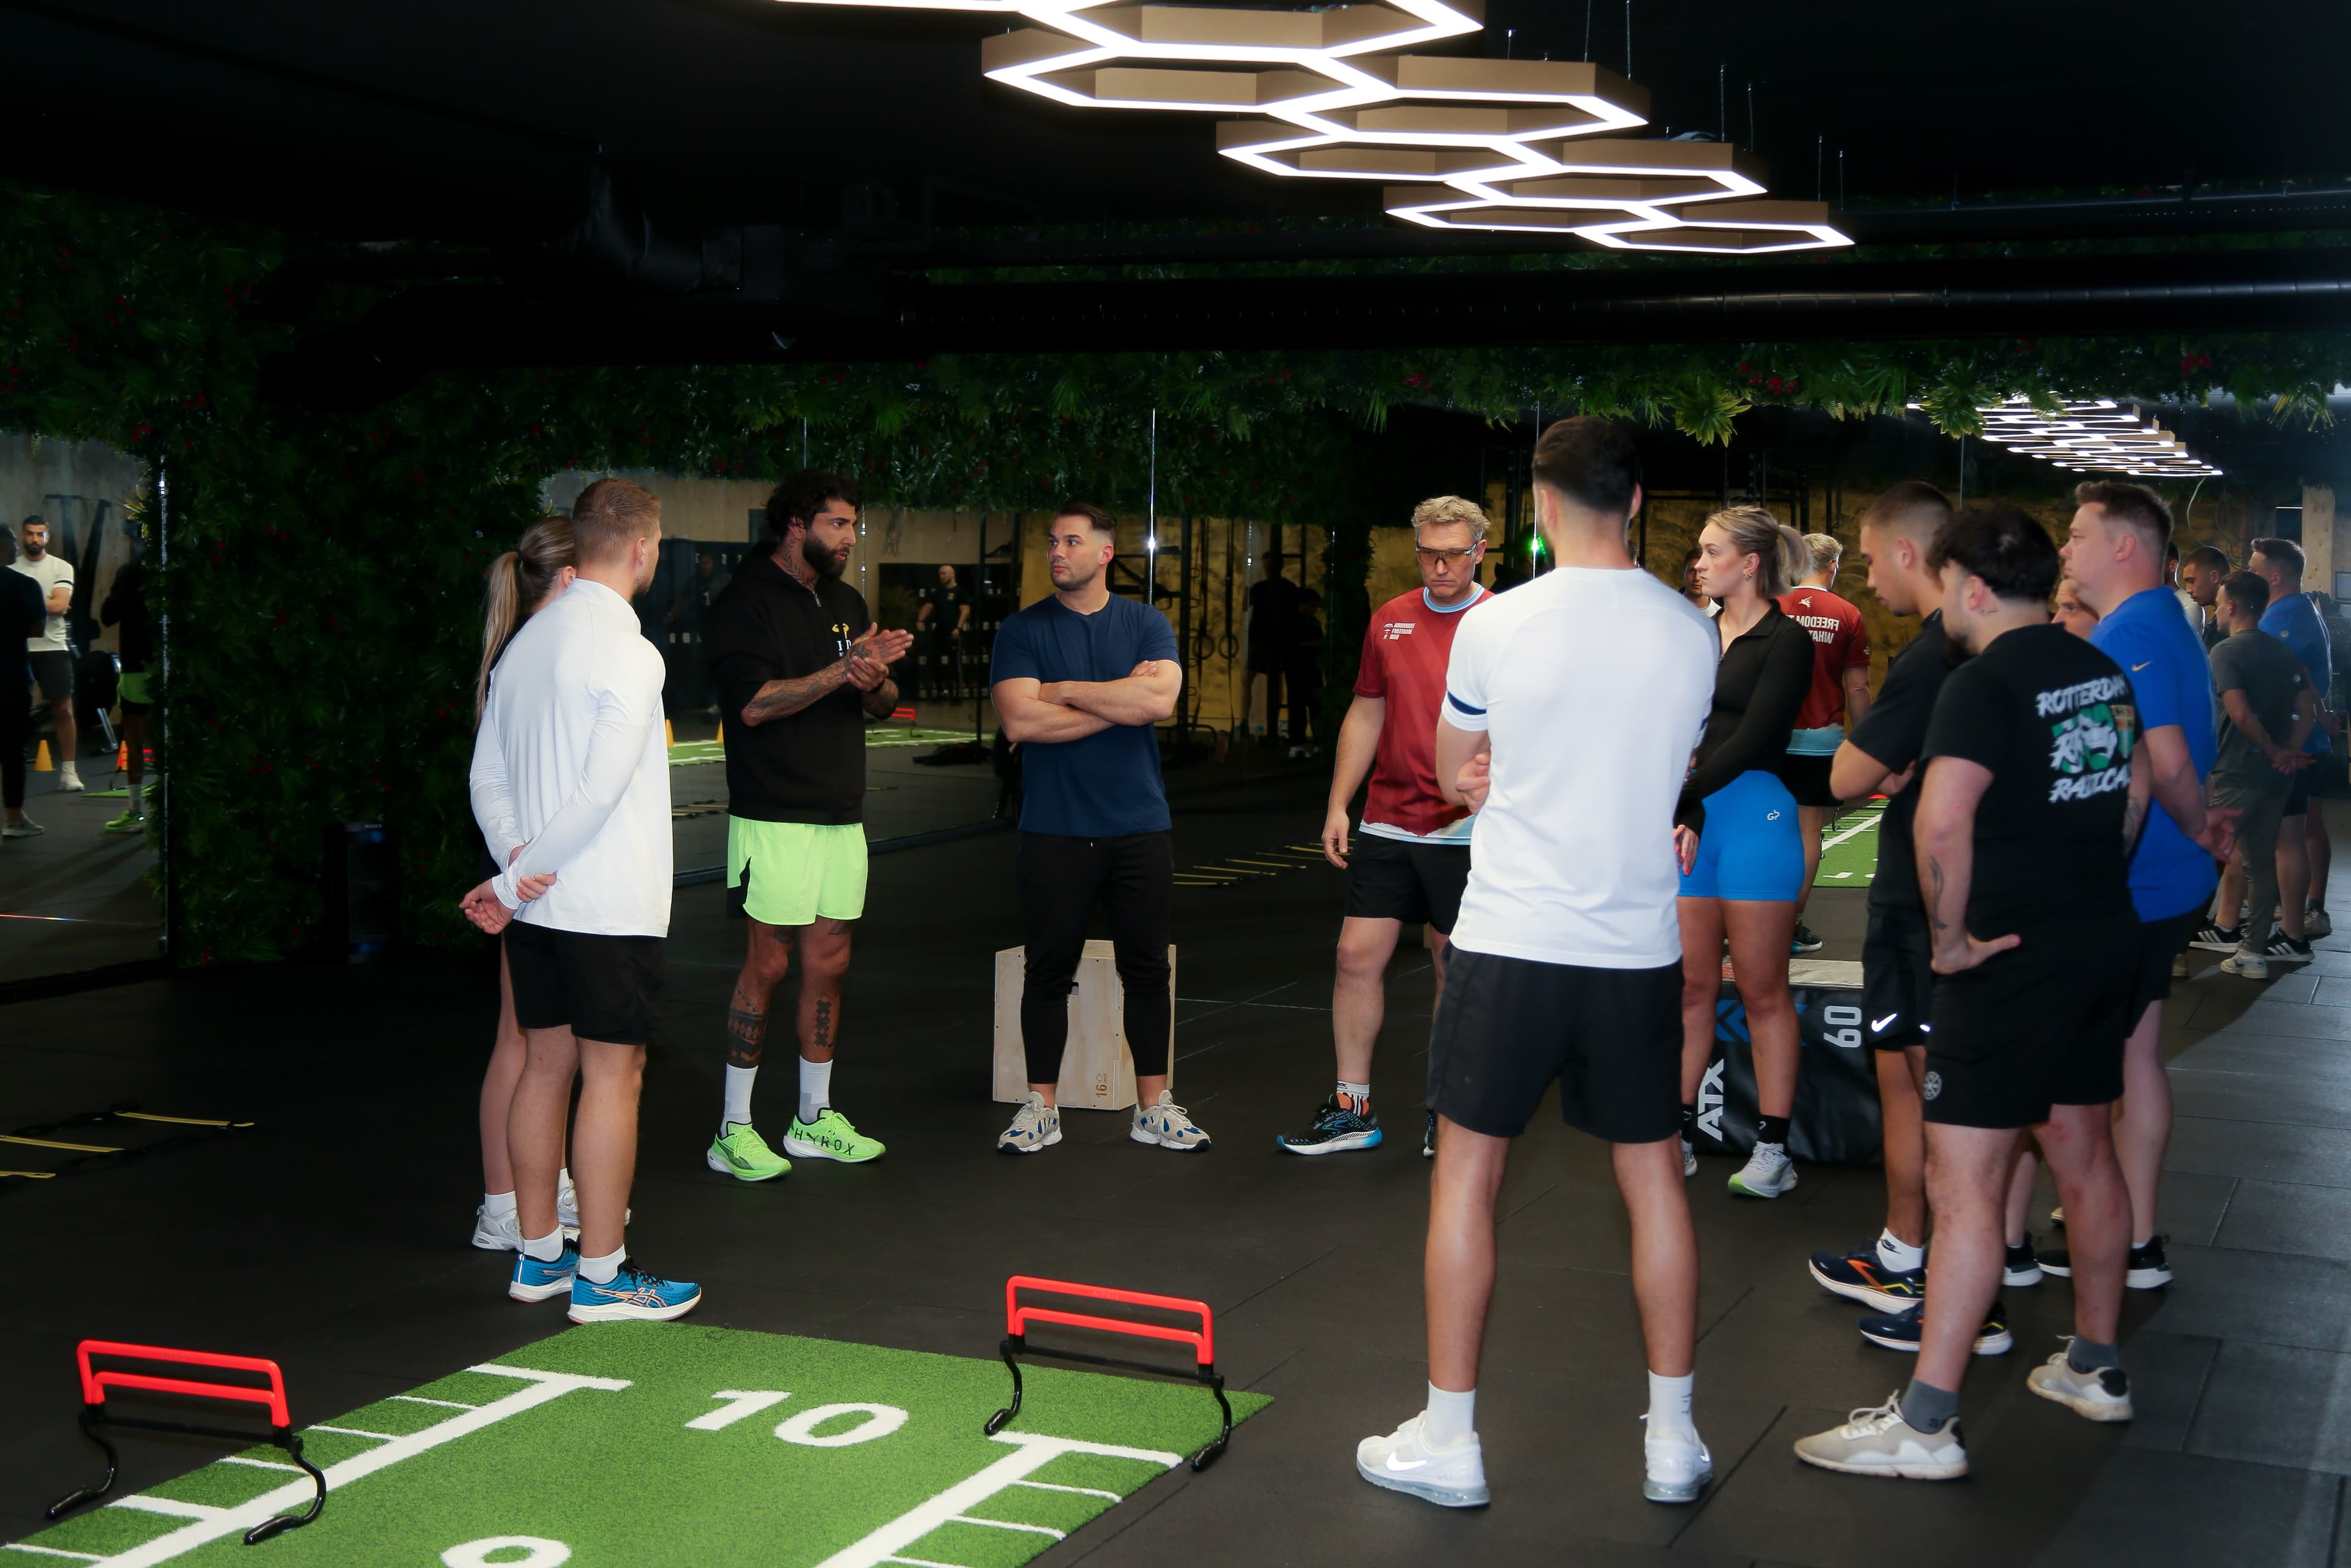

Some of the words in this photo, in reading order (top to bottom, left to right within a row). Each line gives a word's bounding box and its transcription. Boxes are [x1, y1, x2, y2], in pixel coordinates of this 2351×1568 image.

[2047, 763, 2131, 803] RADICA
[1823, 1005, 1862, 1048] 60
[1096, 1085, 1107, 1097] 16
[1698, 1059, 1723, 1142] ATX
[794, 1128, 855, 1156] HYROX
[684, 1389, 909, 1447] 10
